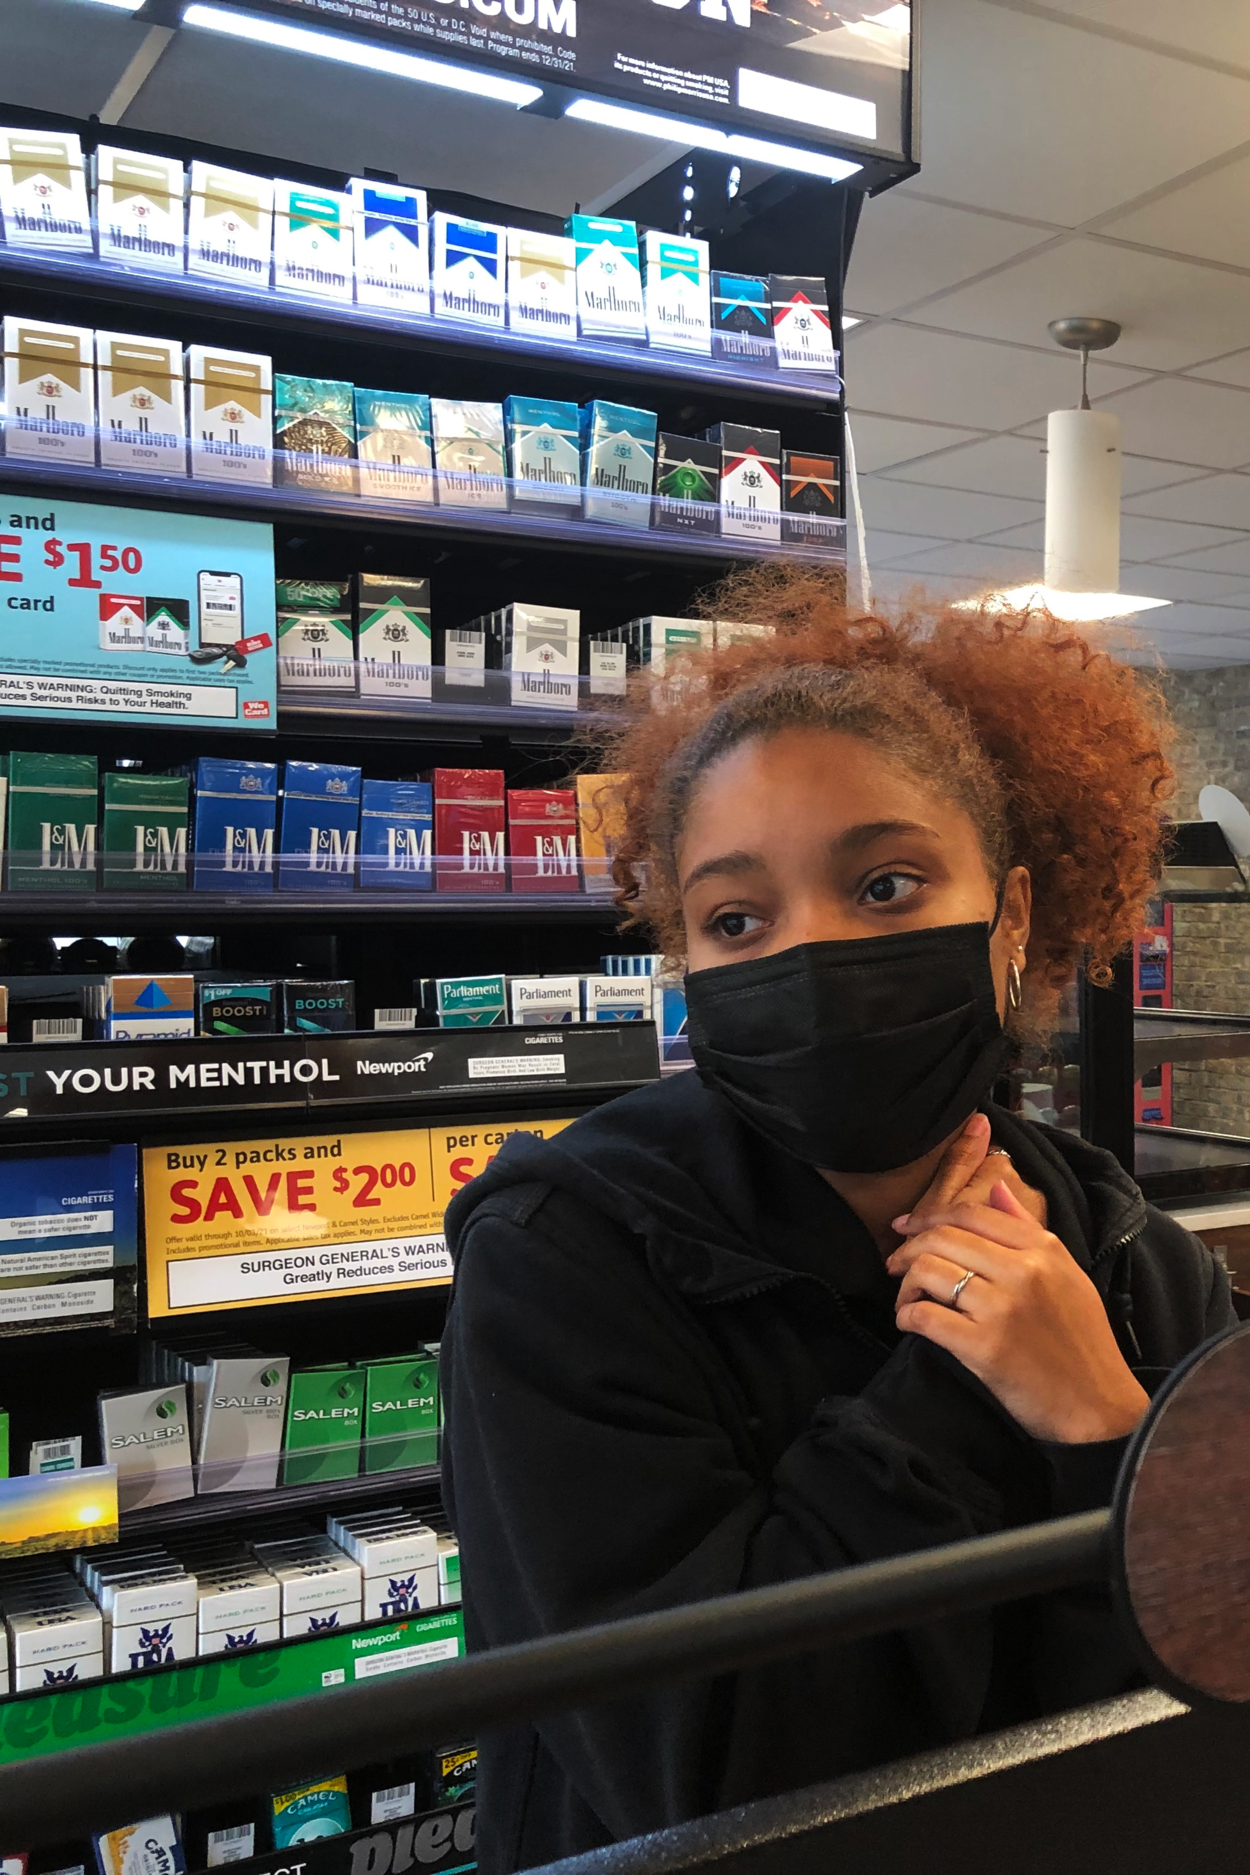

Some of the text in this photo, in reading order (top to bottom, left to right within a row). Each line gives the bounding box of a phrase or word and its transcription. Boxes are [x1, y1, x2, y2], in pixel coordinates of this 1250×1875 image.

[318, 1, 354, 17] specially
[355, 8, 386, 24] marked
[388, 16, 412, 30] packs
[413, 22, 434, 36] while
[436, 29, 468, 45] supplies
[470, 37, 485, 49] last.
[488, 40, 520, 58] Program
[522, 51, 540, 63] ends
[542, 55, 576, 72] 12/31/21.
[391, 4, 404, 16] the
[407, 8, 418, 19] 50
[421, 10, 437, 24] U.S.
[451, 18, 468, 32] D.C.
[470, 24, 487, 37] Void
[490, 30, 513, 44] where
[516, 38, 554, 55] prohibited.
[557, 47, 576, 60] Code
[623, 64, 652, 77] products
[646, 61, 684, 76] information
[14, 203, 82, 235] Marlboro
[109, 224, 176, 258] Marlboro
[198, 239, 262, 274] Marlboro
[442, 289, 500, 318] Marlboro
[518, 297, 570, 326] Marlboro
[584, 286, 642, 314] Marlboro
[721, 330, 770, 358] Marlboro
[781, 336, 834, 364] Marlboro
[15, 404, 86, 438] Marlboro
[110, 416, 178, 449] Marlboro
[201, 429, 266, 460] Marlboro
[284, 444, 350, 476] Marlboro
[520, 456, 576, 486] Marlboro
[443, 464, 504, 492] Marlboro
[593, 464, 648, 494] Marlboro
[660, 489, 715, 522] Marlboro
[725, 495, 779, 525] Marlboro
[9, 512, 56, 532] and
[676, 518, 696, 526] NXT
[789, 511, 837, 537] Marlboro
[7, 596, 55, 612] card
[108, 628, 145, 645] Marlboro
[148, 632, 182, 650] Marlboro
[282, 648, 352, 678] Marlboro
[364, 650, 430, 681] Marlboro
[37, 682, 98, 694] WARNING:
[100, 685, 143, 698] Quitting
[146, 689, 192, 701] Smoking
[520, 668, 572, 696] Marlboro
[30, 692, 73, 704] Serious
[76, 695, 106, 706] Risks
[109, 697, 120, 706] to
[123, 698, 148, 708] Your
[150, 700, 189, 710] Health.
[40, 822, 97, 870] L&M
[134, 825, 188, 873] L&M
[224, 826, 275, 872] L&M
[308, 826, 358, 874] L&M
[386, 827, 432, 872] L&M
[460, 830, 506, 874] L&M
[534, 835, 579, 876] L&M
[295, 998, 345, 1010] BOOST
[443, 984, 500, 999] Parliament
[520, 987, 572, 1000] Parliament
[594, 985, 645, 998] Parliament
[212, 1006, 262, 1017] BOOST
[525, 1036, 564, 1044] CIGARETTES
[45, 1066, 156, 1095] YOUR
[169, 1058, 340, 1089] MENTHOL
[356, 1055, 429, 1077] Newport
[166, 1140, 342, 1173] Buy 2 packs and
[446, 1134, 478, 1153] per
[62, 1194, 114, 1206] CIGARETTES
[169, 1169, 317, 1225] SAVE
[10, 1214, 98, 1230] Organic tobacco NOT
[166, 1236, 183, 1244] Offer
[185, 1234, 203, 1242] valid
[205, 1231, 232, 1241] through
[360, 1218, 380, 1226] Styles.
[383, 1215, 410, 1223] Excludes
[166, 1246, 196, 1255] Includes
[198, 1242, 241, 1252] promotional
[333, 1230, 358, 1238] applies.
[360, 1228, 373, 1236] May
[397, 1223, 428, 1232] combined
[1, 1250, 110, 1265] Natural American Spirit cigarettes
[240, 1255, 315, 1274] SURGEON
[319, 1246, 400, 1266] GENERAL'S
[283, 1258, 447, 1285] Greatly Reduces Serious
[214, 1395, 283, 1408] SALEM
[293, 1407, 359, 1421] SALEM
[372, 1396, 434, 1413] SALEM
[111, 1424, 185, 1449] SALEM
[404, 1553, 426, 1561] PACK
[352, 1622, 407, 1650] Newport
[416, 1617, 458, 1632] CIGARETTES
[287, 1792, 336, 1815] CAMEL
